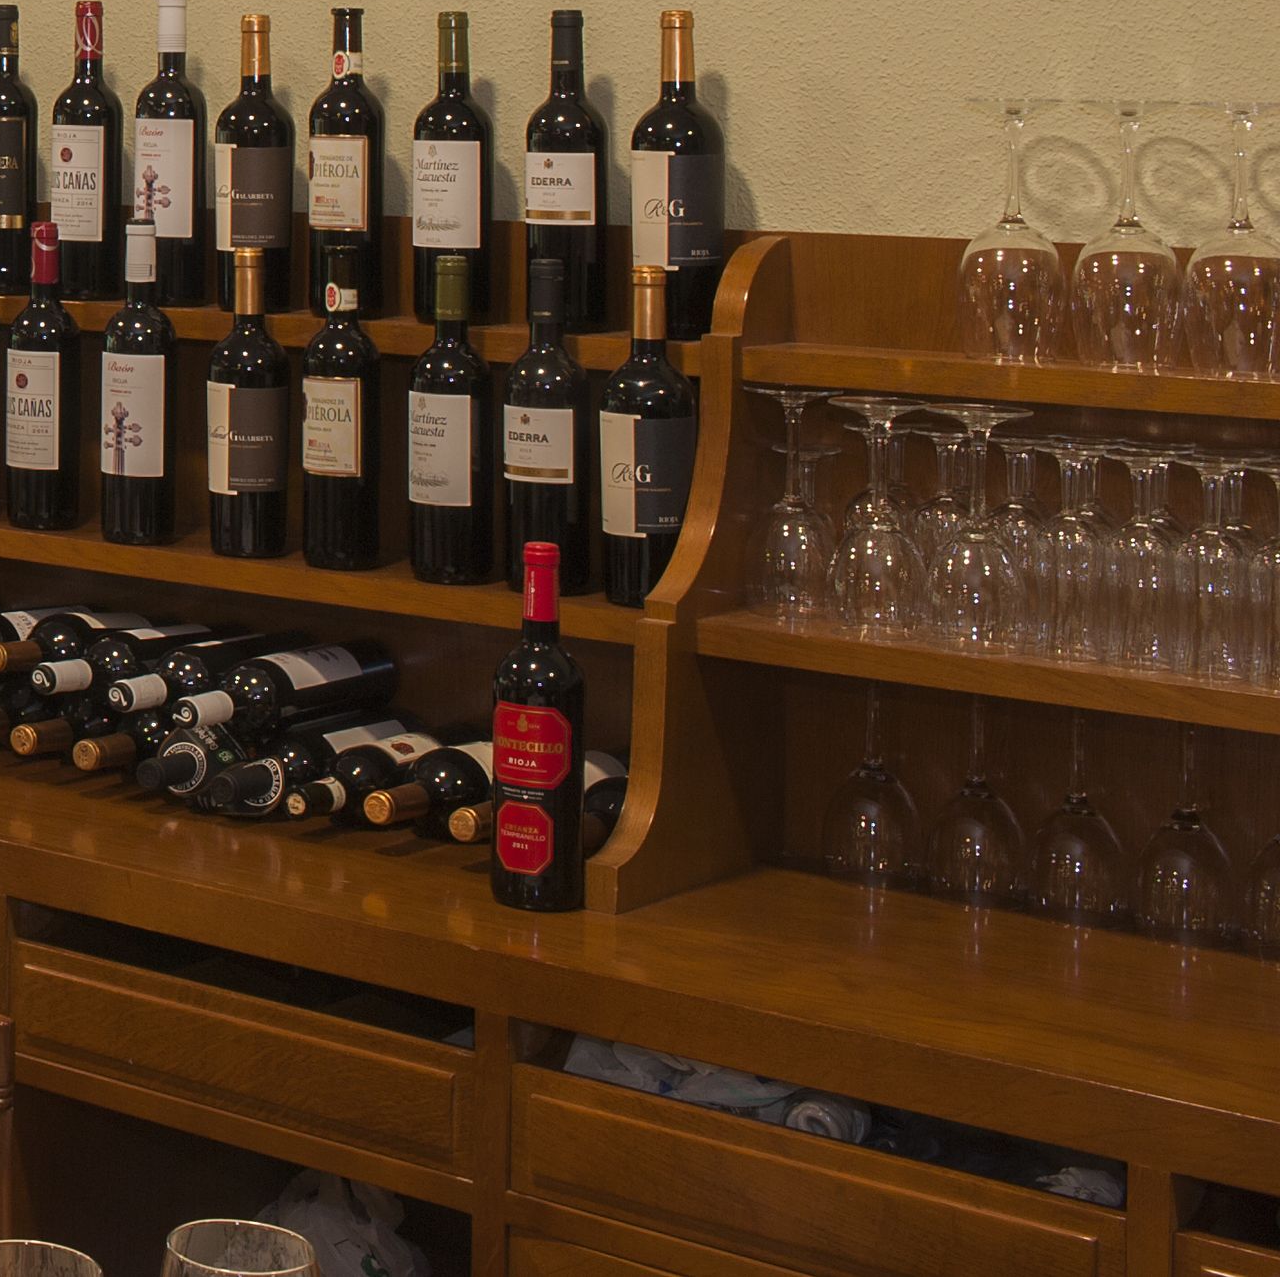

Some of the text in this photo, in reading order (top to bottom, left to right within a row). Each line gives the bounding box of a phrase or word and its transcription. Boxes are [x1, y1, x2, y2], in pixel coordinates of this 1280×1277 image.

[314, 162, 360, 179] PIÉROLA
[415, 158, 460, 171] Martínez
[63, 170, 96, 191] CAÑAS
[416, 172, 457, 183] Lacuesta
[531, 176, 573, 187] EDERRA
[11, 357, 32, 365] RIOJA
[18, 396, 52, 418] CAÑAS
[307, 406, 352, 423] PIÉROLA
[508, 430, 549, 444] EDERRA
[508, 756, 537, 768] RIOJA
[500, 828, 546, 842] TEMPRANILLO
[504, 823, 539, 835] CRIANZA
